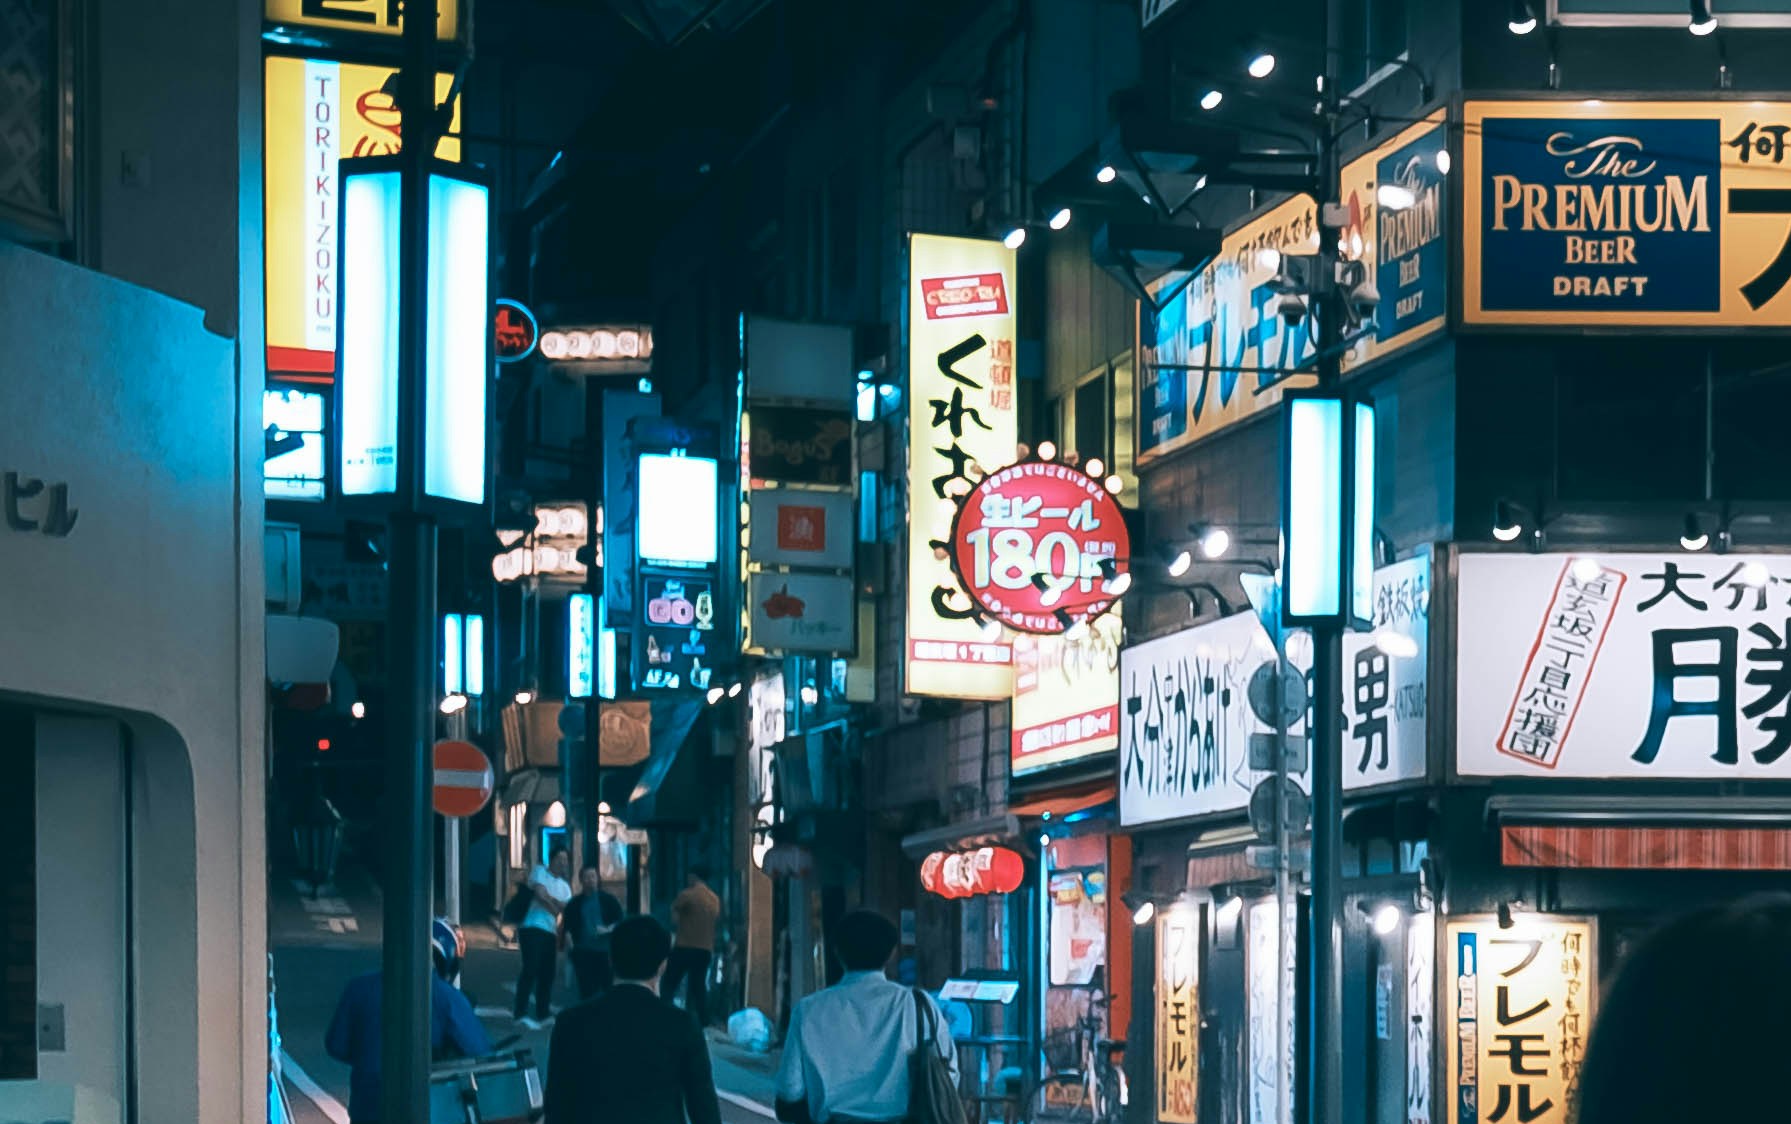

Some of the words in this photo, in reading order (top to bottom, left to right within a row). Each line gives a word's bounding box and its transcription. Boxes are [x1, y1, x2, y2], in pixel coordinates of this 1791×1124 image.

[1545, 131, 1656, 178] The
[315, 76, 331, 319] TORIKIZOKU
[1492, 174, 1711, 234] PREMIUM
[1565, 236, 1637, 265] BEER
[1553, 276, 1648, 297] DRAFT
[4, 471, 79, 538] ビル
[981, 493, 1100, 532] 生ビール
